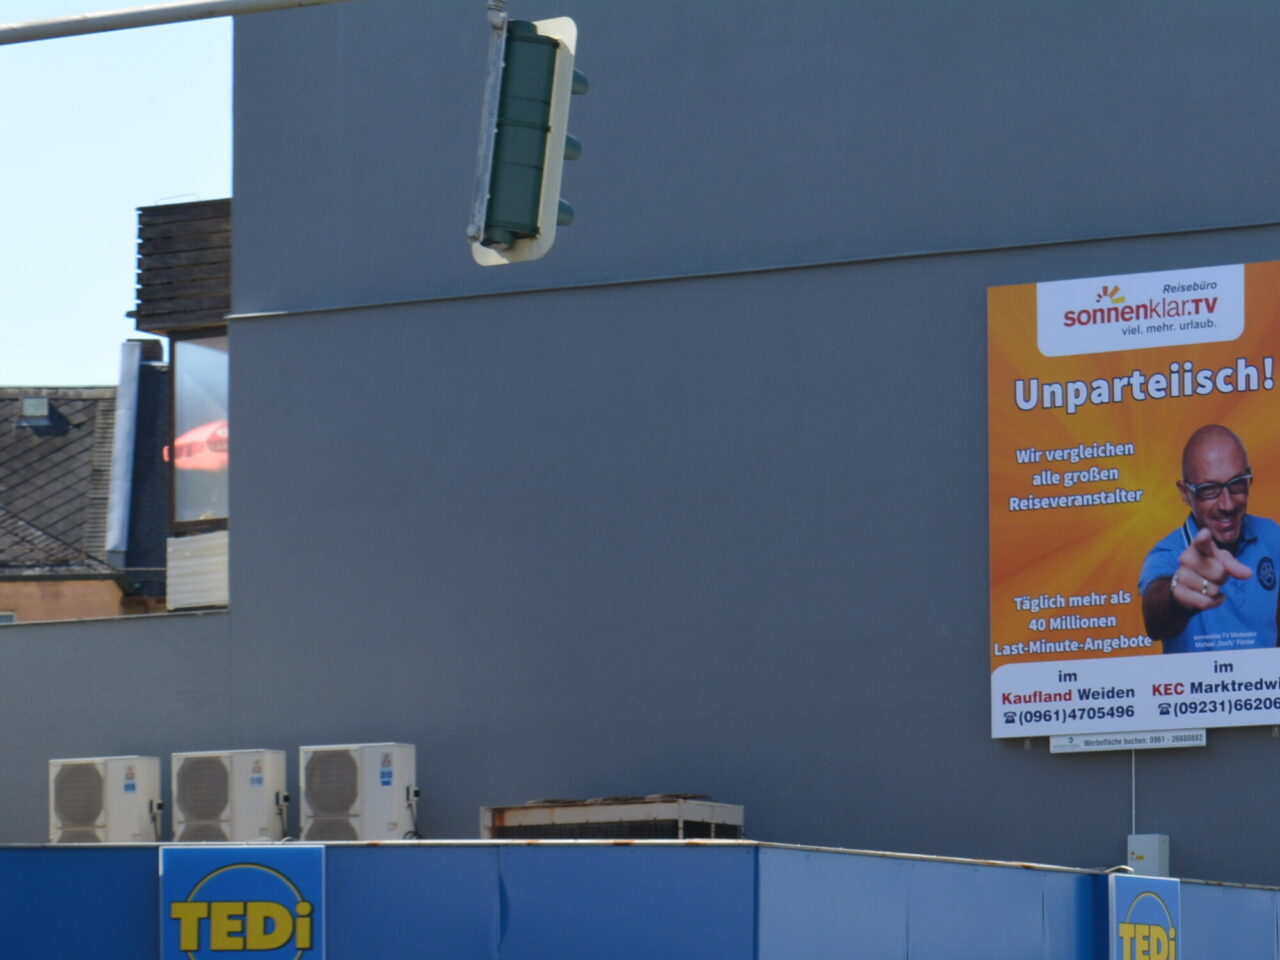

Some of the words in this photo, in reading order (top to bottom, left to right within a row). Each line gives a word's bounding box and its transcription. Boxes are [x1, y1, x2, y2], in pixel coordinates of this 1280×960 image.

[1162, 280, 1217, 294] Reisebüro
[1063, 296, 1219, 327] sonnenklar.TV
[1121, 325, 1142, 336] viel.
[1146, 322, 1175, 334] mehr.
[1179, 318, 1217, 332] urlaub.
[1014, 356, 1275, 415] Unparteiisch!
[1016, 448, 1043, 465] Wir
[1045, 442, 1136, 464] vergleichen
[1032, 471, 1061, 486] alle
[1063, 467, 1120, 487] großen
[1009, 488, 1144, 512] Reiseveranstalter
[1014, 594, 1066, 613] Täglich
[1069, 593, 1107, 608] mehr
[1110, 591, 1132, 605] als
[1029, 617, 1047, 632] 40
[1049, 614, 1117, 631] Millionen
[994, 634, 1153, 656] Last-Minute-Angebote
[1058, 670, 1078, 682] im
[1213, 660, 1234, 674] im
[1001, 689, 1073, 705] Kaufland
[1078, 687, 1135, 701] Weiden
[1152, 682, 1186, 696] KEC
[1018, 704, 1135, 725] (0961)4705496
[171, 901, 314, 951] TEDi
